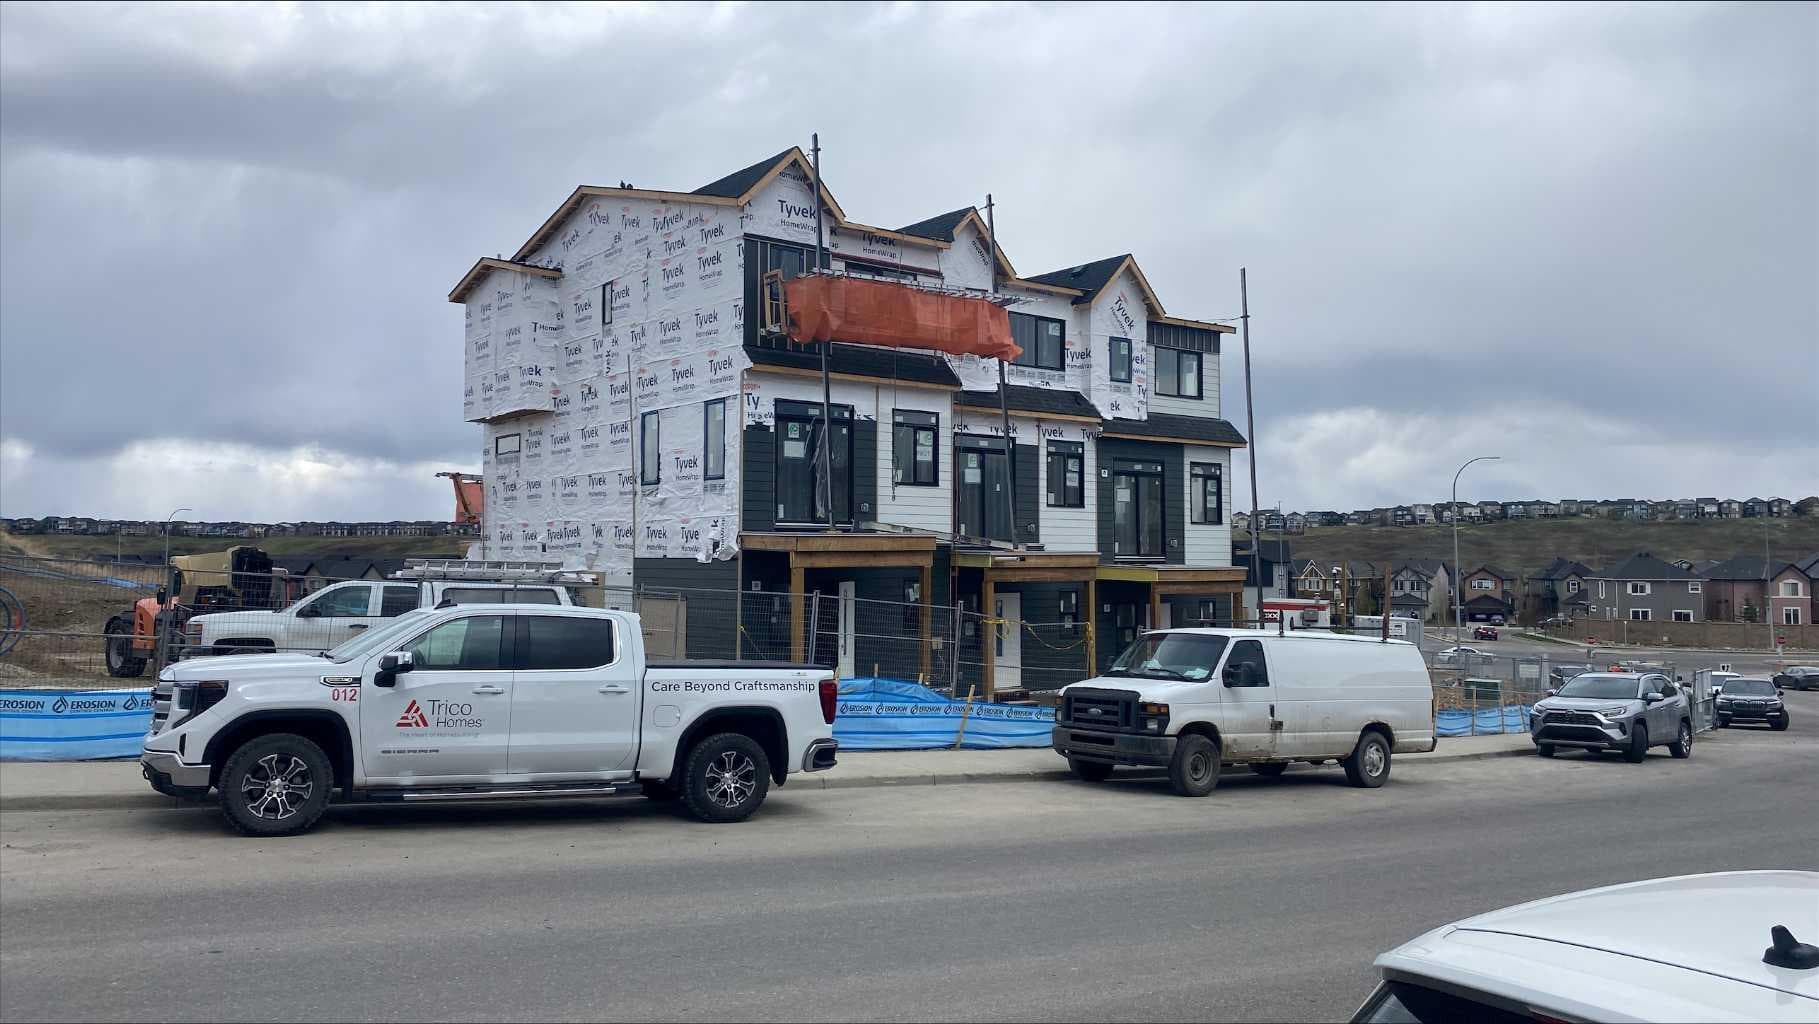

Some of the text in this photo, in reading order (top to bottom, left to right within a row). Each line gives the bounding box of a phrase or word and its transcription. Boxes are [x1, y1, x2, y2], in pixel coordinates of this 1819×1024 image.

[778, 199, 816, 219] Tyvek
[700, 223, 724, 244] Tyvek
[664, 235, 686, 257] Tyvek
[862, 247, 897, 258] HomeWrap
[698, 250, 722, 272] Tyvek
[662, 263, 684, 283] Tyvek
[695, 307, 718, 329] Tyvek
[1115, 296, 1134, 330] Tyvek
[659, 317, 681, 337] Tyvek
[1065, 348, 1091, 361] Tyvek
[672, 363, 694, 384] Tyvek
[708, 355, 733, 375] Tyvek
[638, 372, 659, 390] Tyvek
[1036, 424, 1064, 439] Tyvek
[674, 456, 698, 472] Tyvek
[646, 526, 667, 541] Tyvek
[680, 526, 699, 543] Tyve
[332, 688, 357, 701] 012
[651, 681, 815, 693] Care Beyond Craftsmanship
[0, 700, 45, 709] EROSION
[71, 700, 116, 709] EROSION
[427, 699, 472, 716] Trico
[436, 717, 482, 728] Homes
